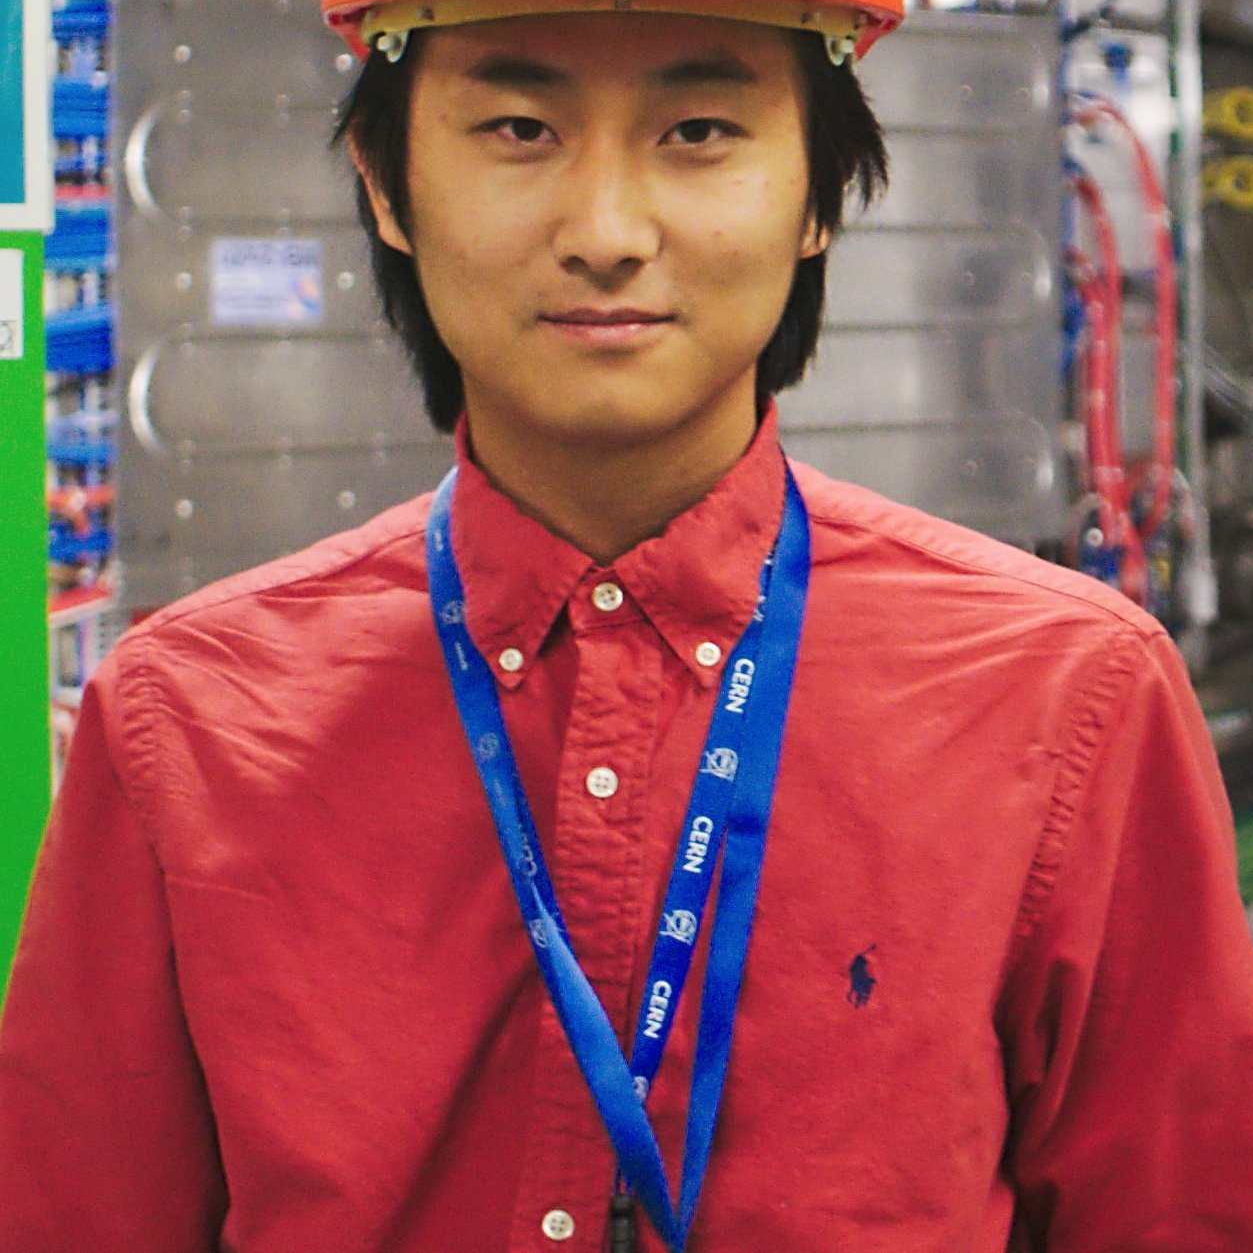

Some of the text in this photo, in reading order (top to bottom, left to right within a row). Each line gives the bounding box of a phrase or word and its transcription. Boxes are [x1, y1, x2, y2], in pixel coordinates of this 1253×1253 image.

[724, 658, 755, 714] CERN
[682, 815, 713, 874] CERN
[643, 980, 672, 1039] CERN
